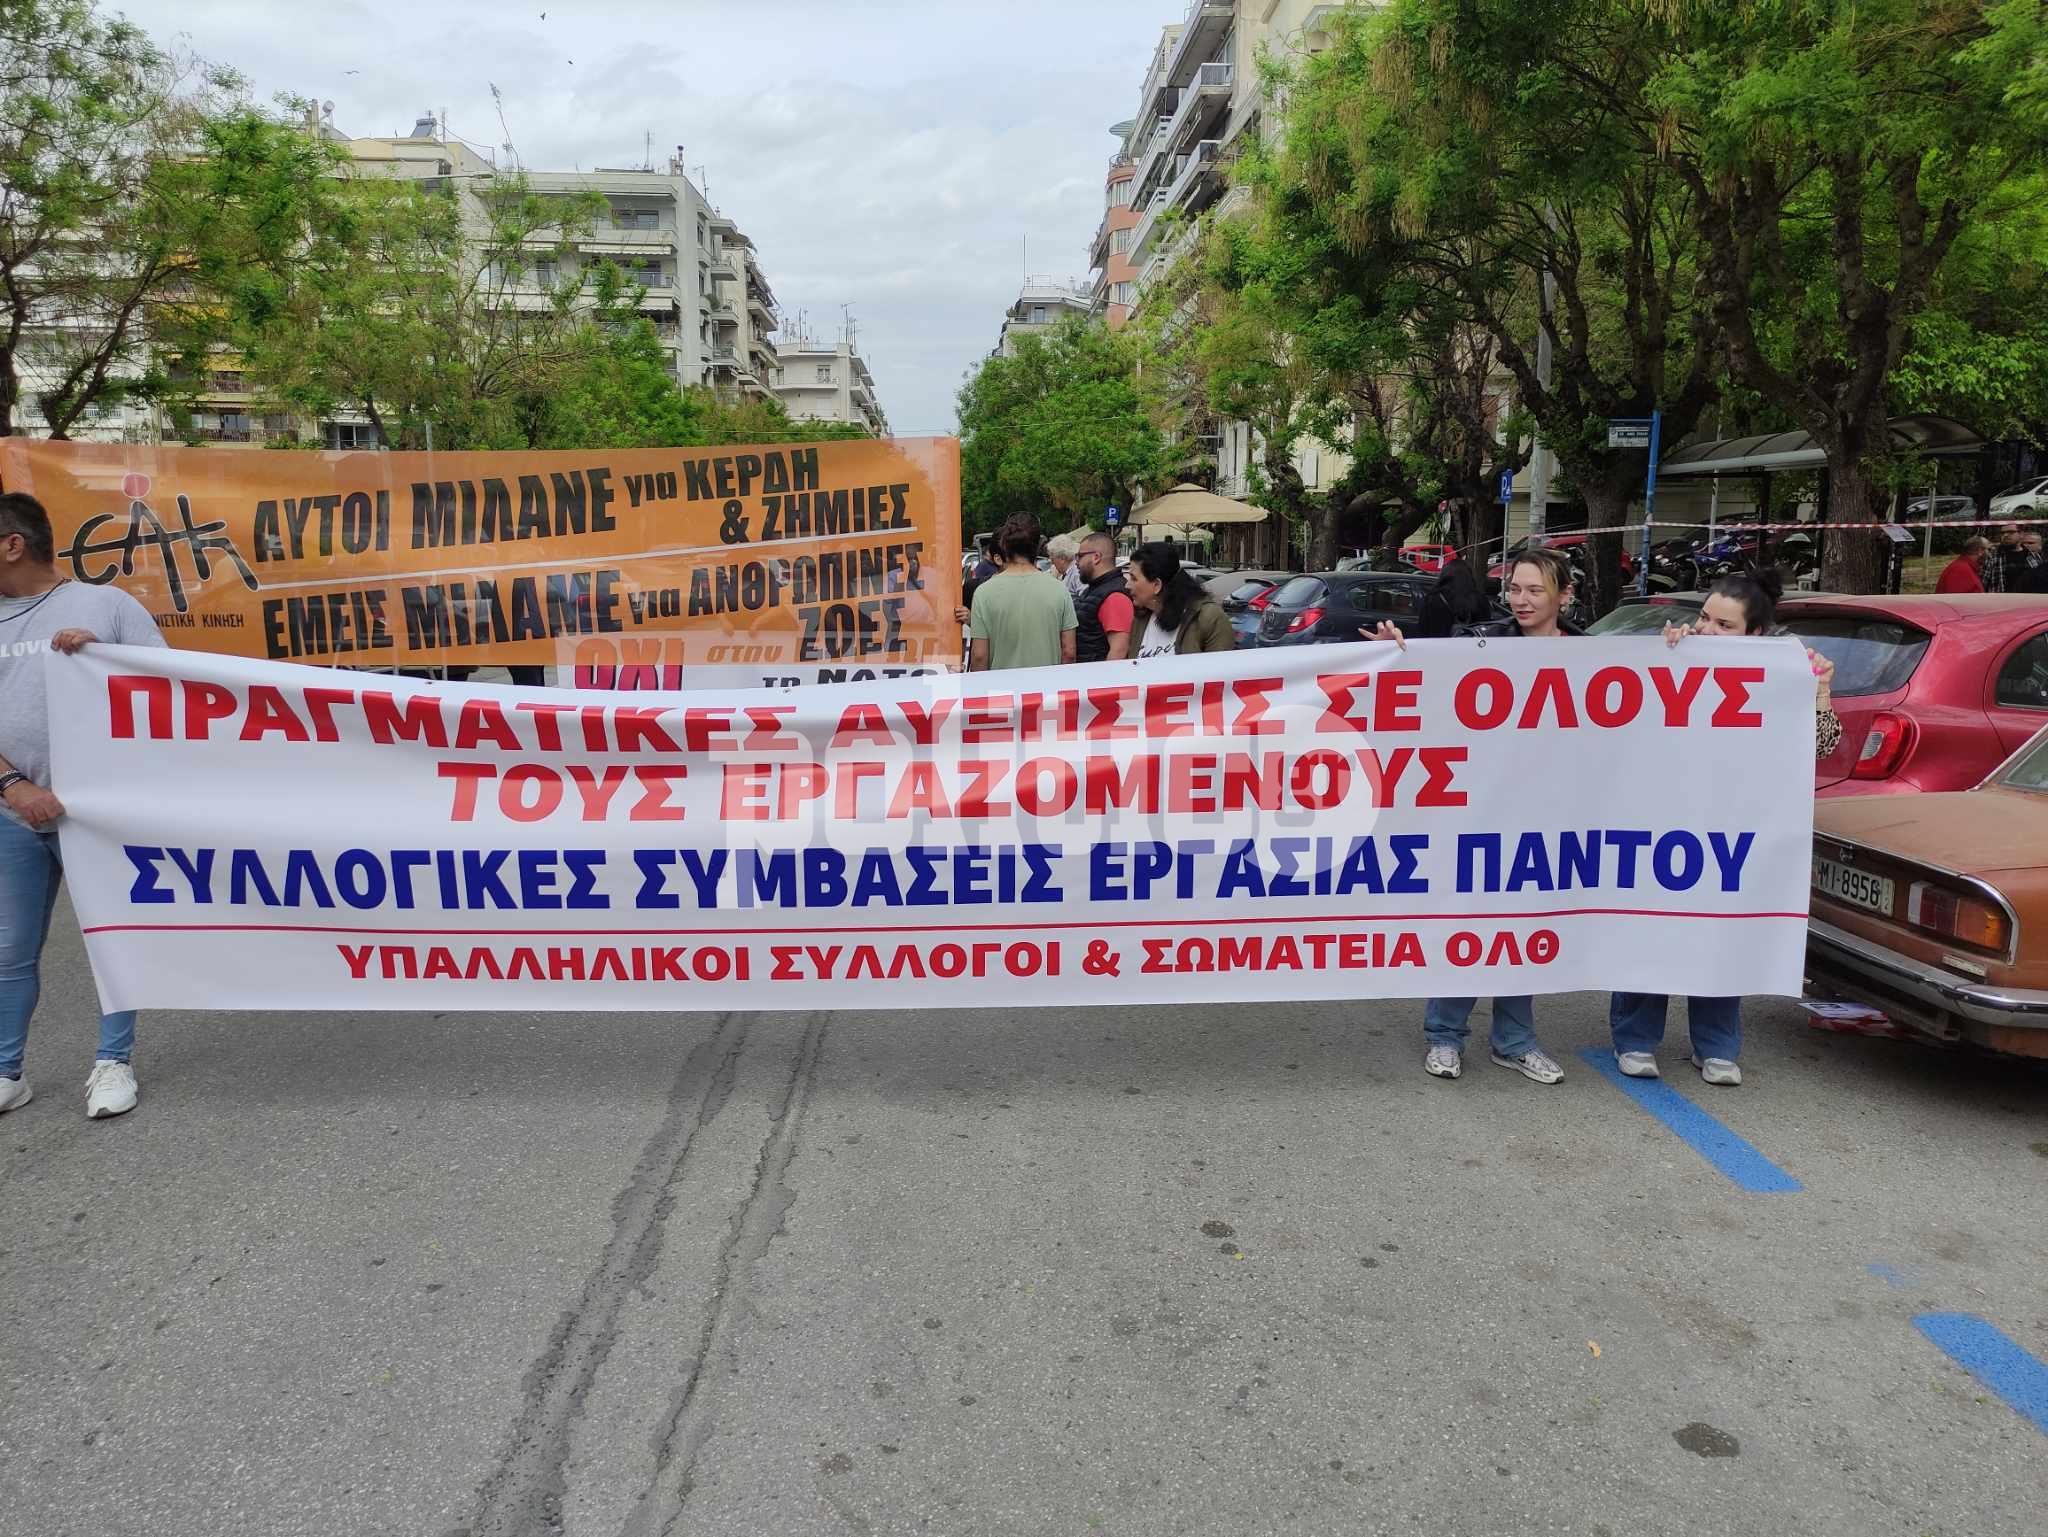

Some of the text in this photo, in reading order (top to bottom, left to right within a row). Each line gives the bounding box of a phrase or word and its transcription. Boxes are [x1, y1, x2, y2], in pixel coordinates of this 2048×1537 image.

[253, 447, 820, 563] ΑΥΤΟΙ ΜΙΛΑΝΕ για ΚΕΡΔΗ
[720, 483, 911, 545] & ΖΗΜΙΕΣ
[203, 614, 244, 628] ΚΙΝΗΣΗ
[263, 542, 924, 659] ΕΜΕΙΣ ΜΙΛΑΜΕ για ΑΝΘΡΩΠΙΝΕΣ
[799, 598, 906, 662] ΖΩΕΣ
[107, 667, 1766, 753] ΠΡΑΓΜΑΤΙΚΕΣ ΑΥΞΗΣΕΙΣ ΣΕ ΟΛΟΥΣ
[438, 745, 1469, 822] ΤΟΥΣ ΕΡΓΑΖΟΜΕΝΟΥΣ
[123, 829, 1756, 910] ΣΥΛΛΟΓΙΚΕΣ ΣΥΜΒΑΣΕΙΣ ΕΡΓΑΣΙΑΣ ΠΑΝΤΟΥ
[336, 928, 1561, 982] ΥΠΑΛΛΗΛΙΚΟΙ ΣΥΛΛΟΓΟΙ & ΣΩΜΑΤΕΙΑ ΟΛΘ
